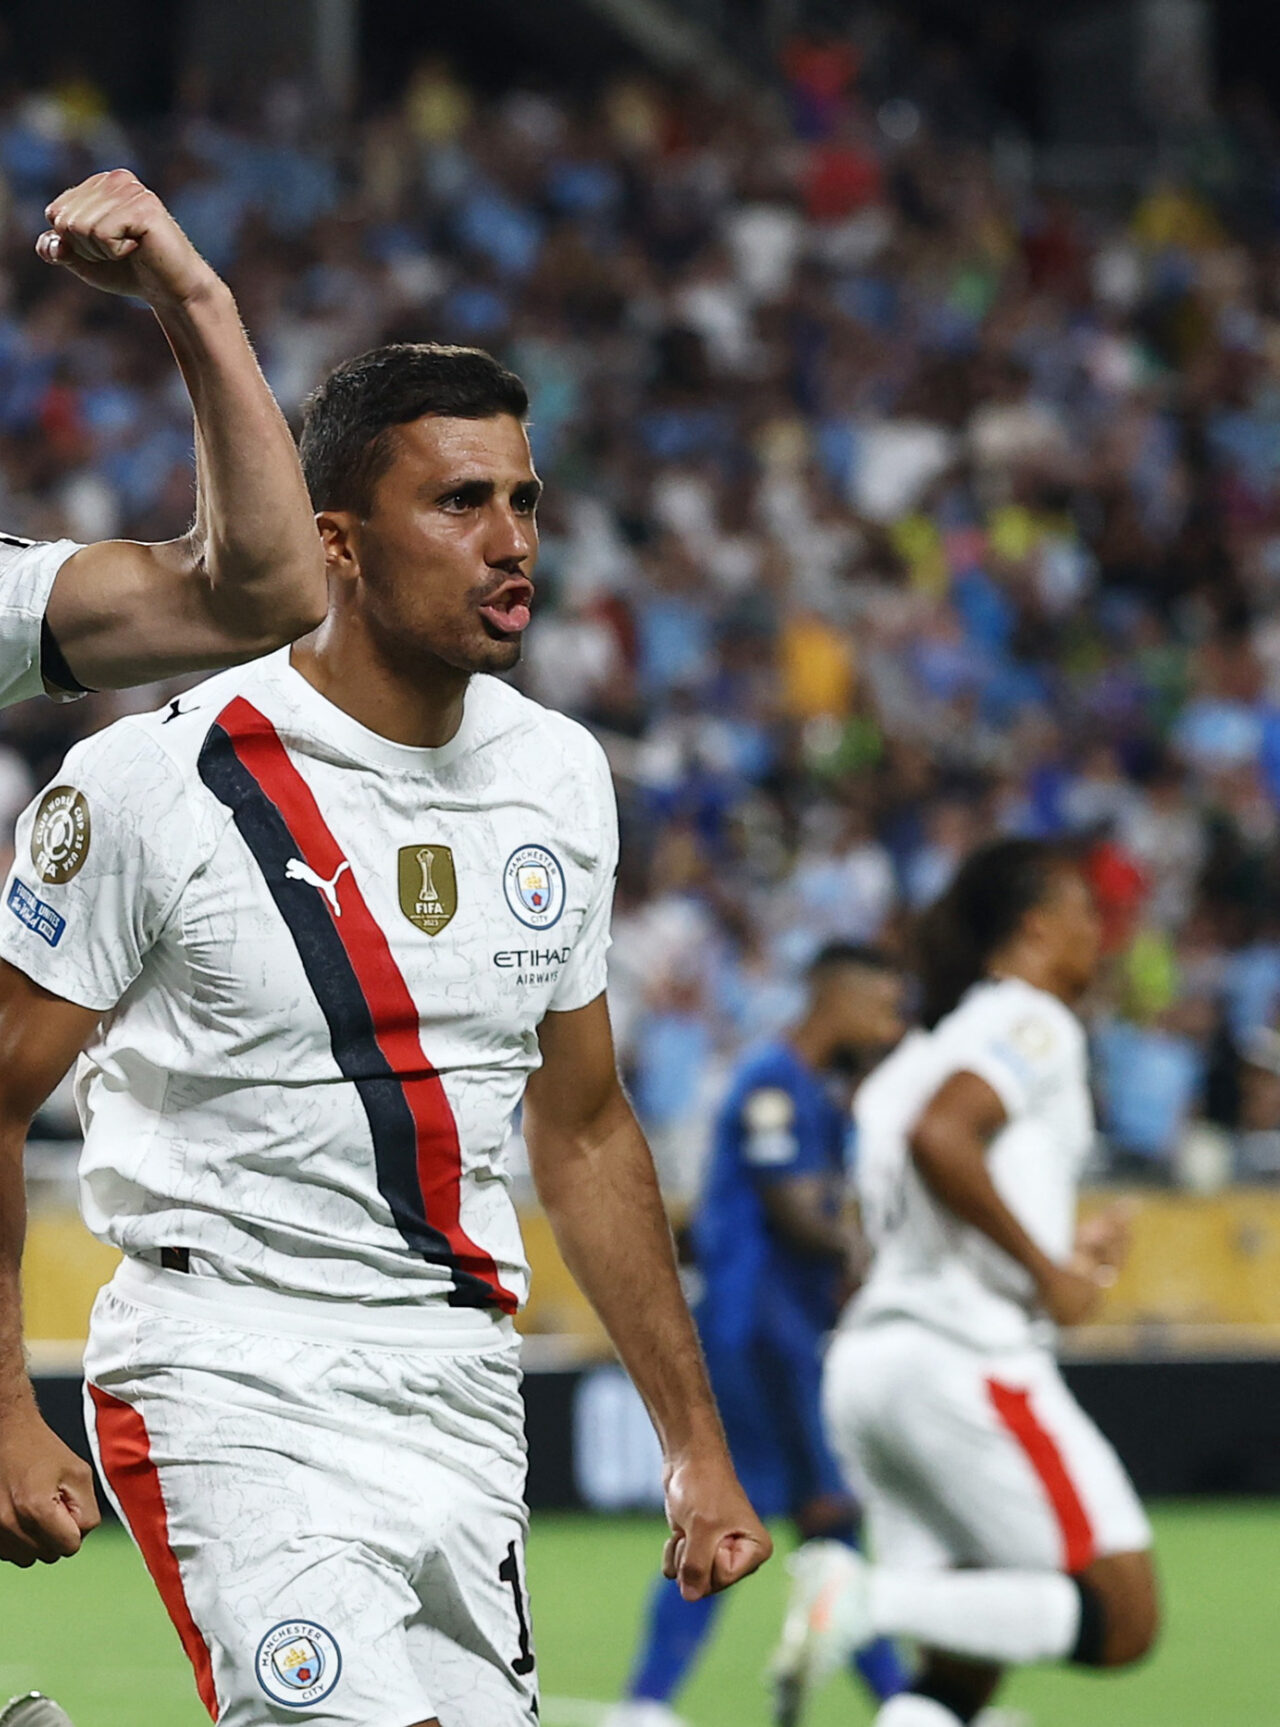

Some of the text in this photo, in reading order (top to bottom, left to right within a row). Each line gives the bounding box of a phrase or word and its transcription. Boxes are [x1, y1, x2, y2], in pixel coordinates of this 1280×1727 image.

[73, 806, 86, 831] CUP
[74, 833, 85, 851] 25
[61, 851, 80, 872] USA
[508, 851, 557, 877] MANCHESTER
[415, 902, 444, 914] FIFA
[530, 914, 548, 924] CITY
[493, 947, 572, 968] ETIHAD
[516, 971, 559, 986] AIRWAYS
[262, 1625, 322, 1667] MANCHESTER
[302, 1683, 325, 1700] CITY
